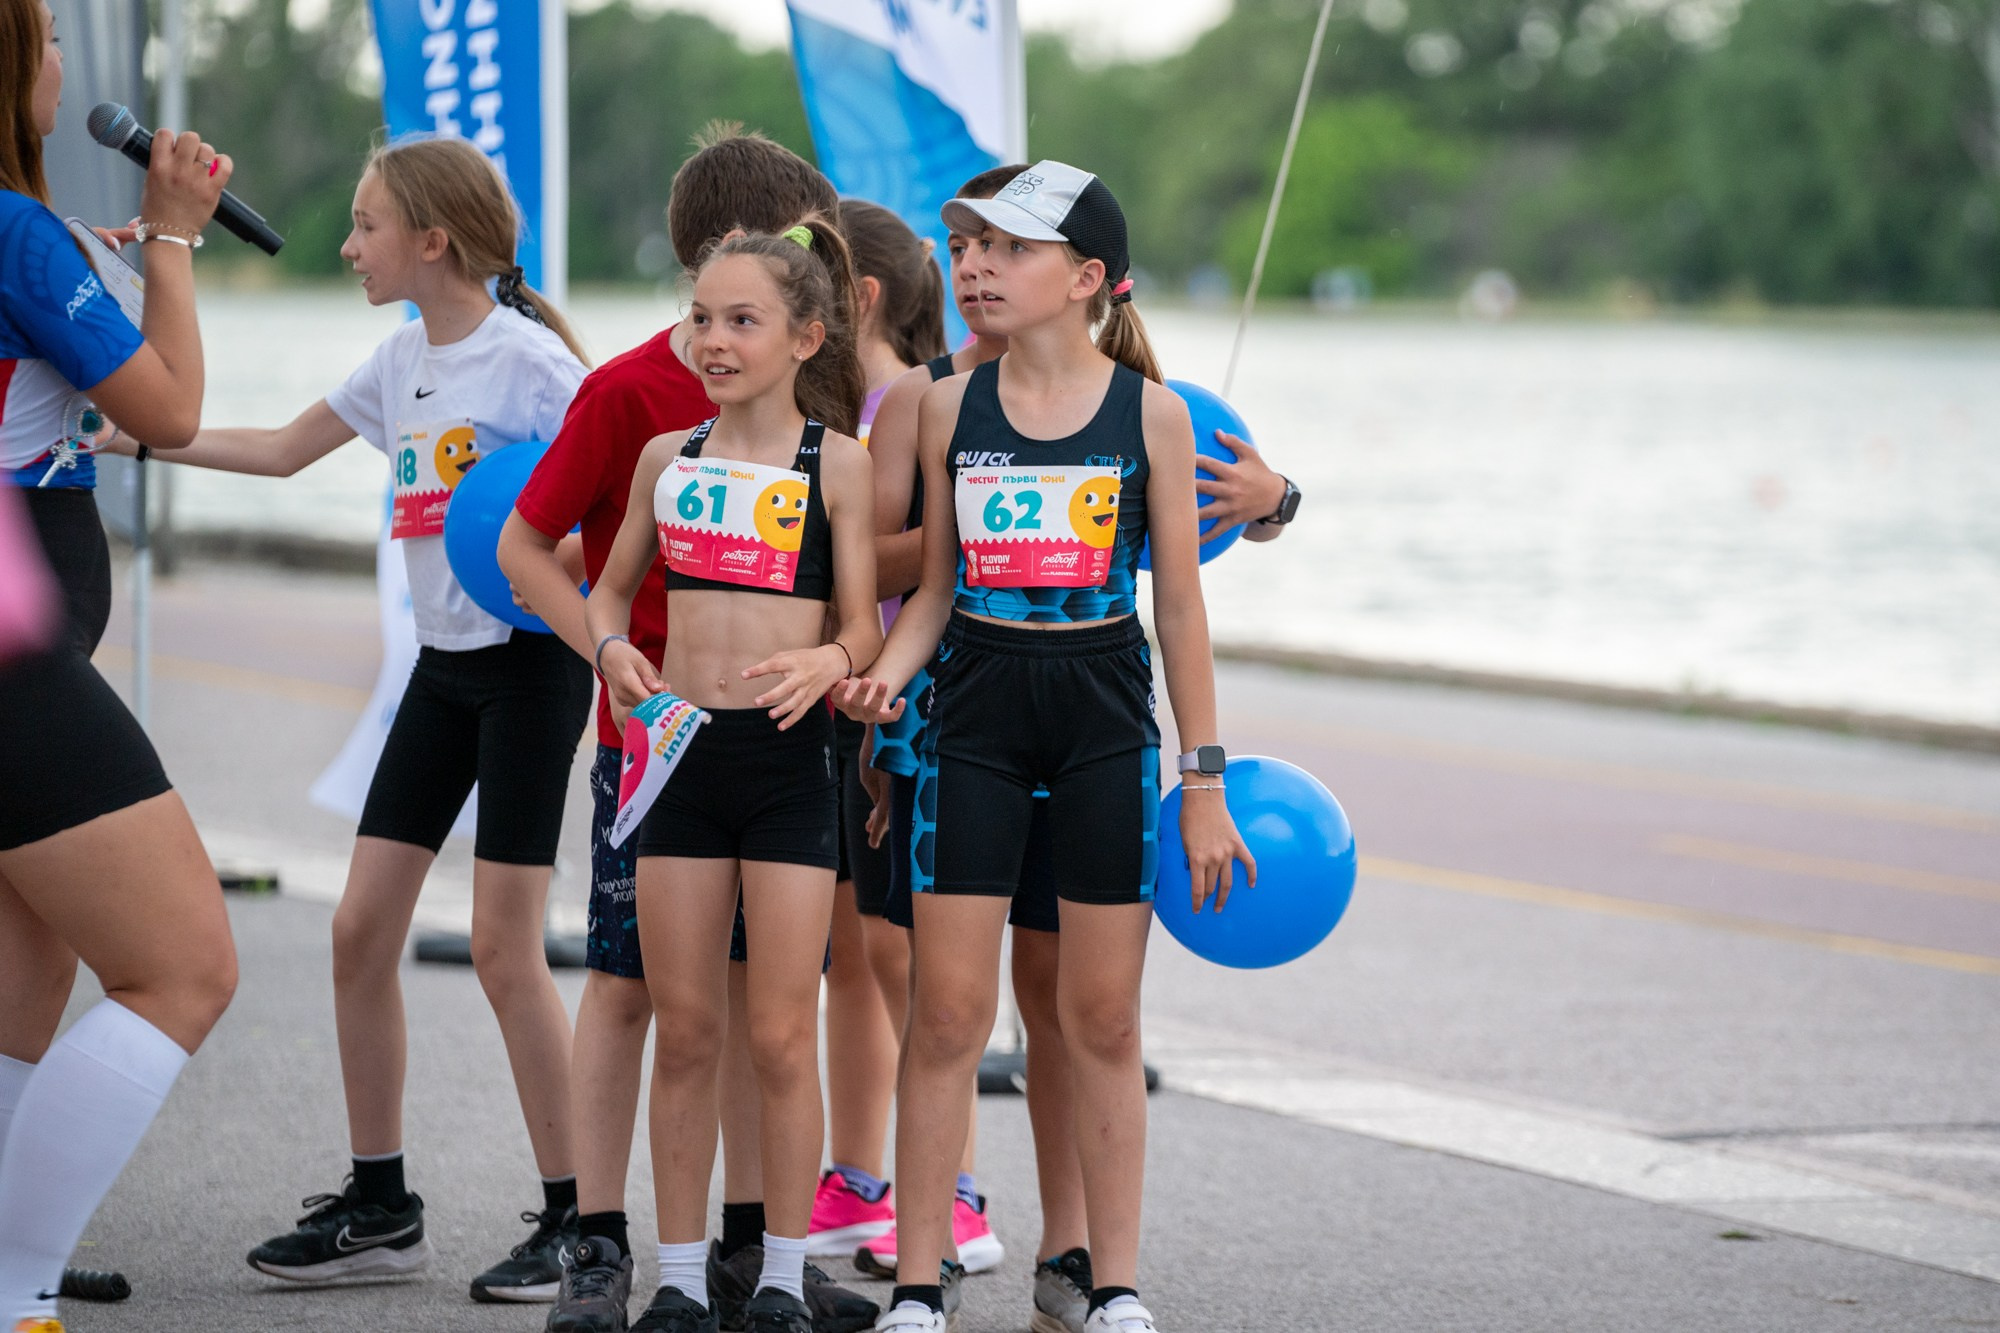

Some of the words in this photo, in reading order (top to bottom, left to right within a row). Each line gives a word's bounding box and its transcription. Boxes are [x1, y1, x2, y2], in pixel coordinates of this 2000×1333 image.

[955, 451, 1015, 467] QUICK
[677, 479, 727, 524] 61
[983, 489, 1043, 533] 62
[669, 538, 694, 552] PLOVDIV
[980, 554, 1011, 565] PLOVDIV
[981, 565, 1001, 575] HILLS
[654, 706, 697, 757] ърви
[665, 708, 701, 765] естит
